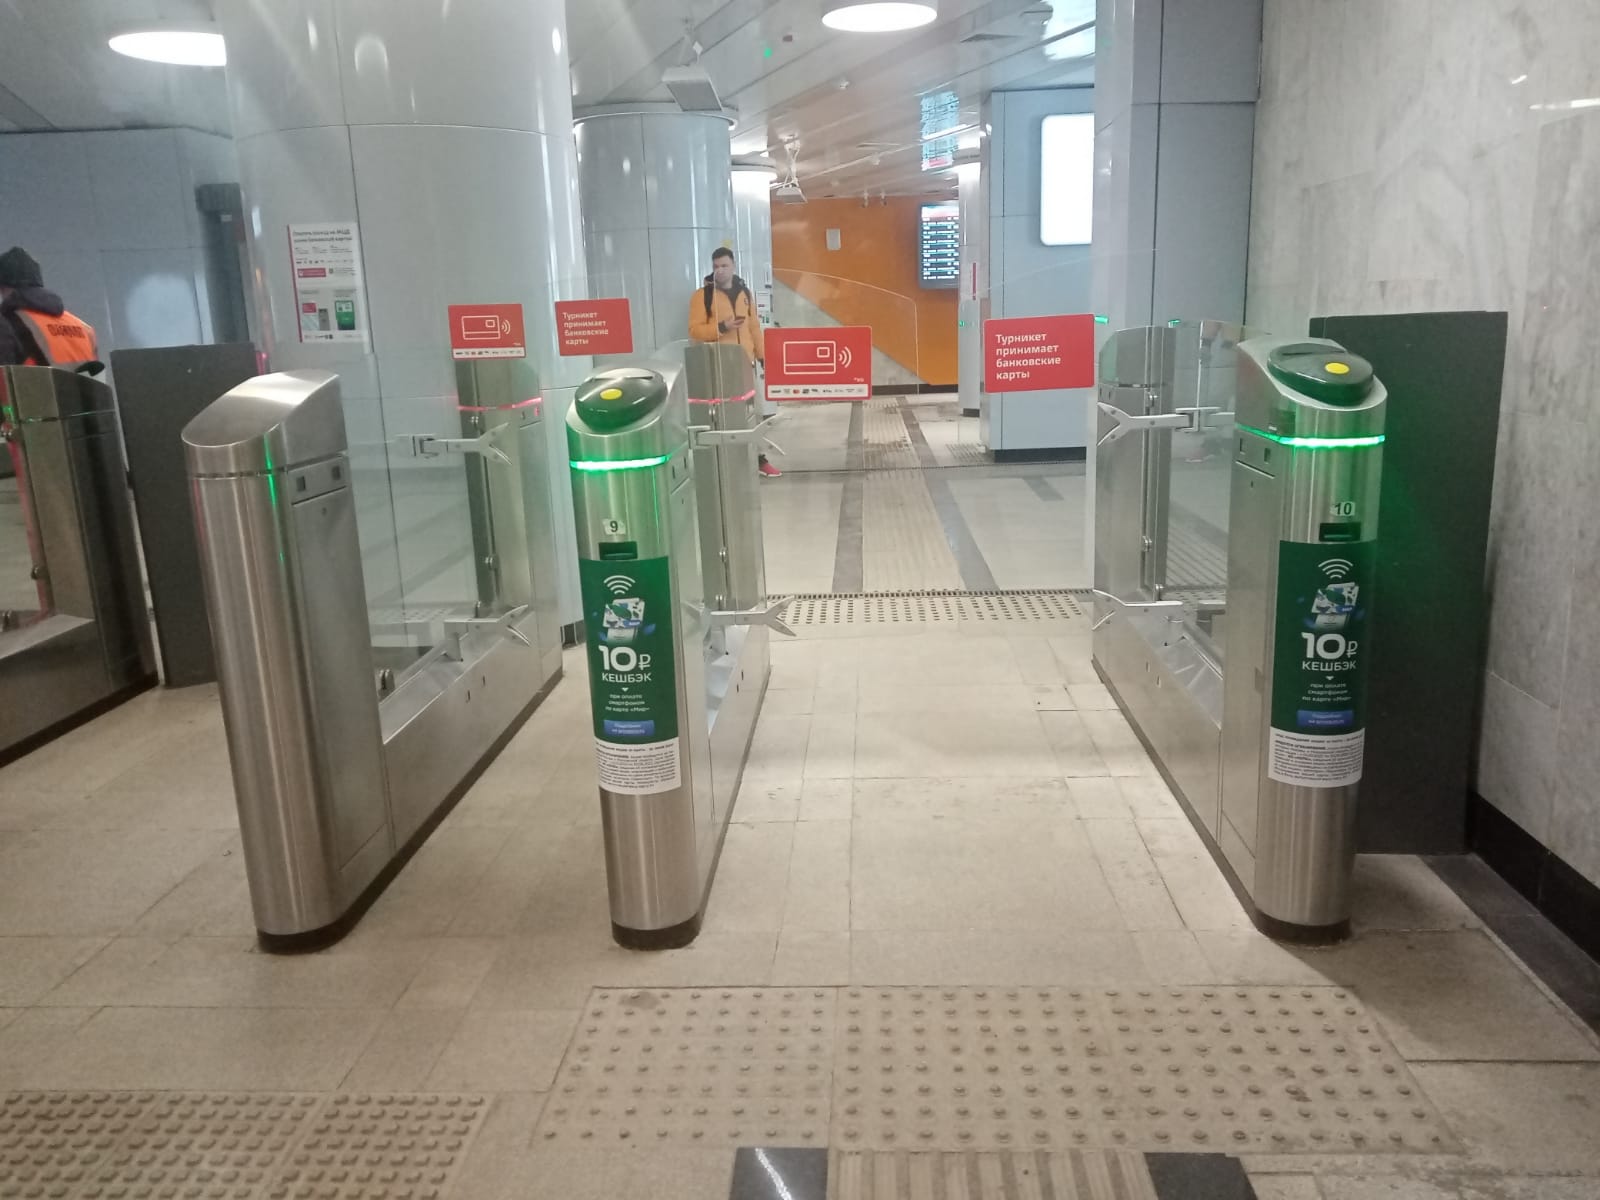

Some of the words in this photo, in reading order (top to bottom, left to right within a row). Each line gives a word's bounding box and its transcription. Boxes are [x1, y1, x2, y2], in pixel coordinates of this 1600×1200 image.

[562, 312, 598, 321] Турникет
[563, 320, 607, 329] принимает
[564, 329, 609, 337] банковские
[565, 338, 590, 346] карты
[995, 333, 1047, 346] Турникет
[995, 344, 1059, 358] принимает
[995, 357, 1062, 368] банковские
[995, 371, 1031, 382] карты
[1335, 502, 1352, 515] 10
[610, 520, 619, 533] 9
[1302, 660, 1357, 671] КЕШБЭК
[601, 672, 652, 683] КЕШБЭК
